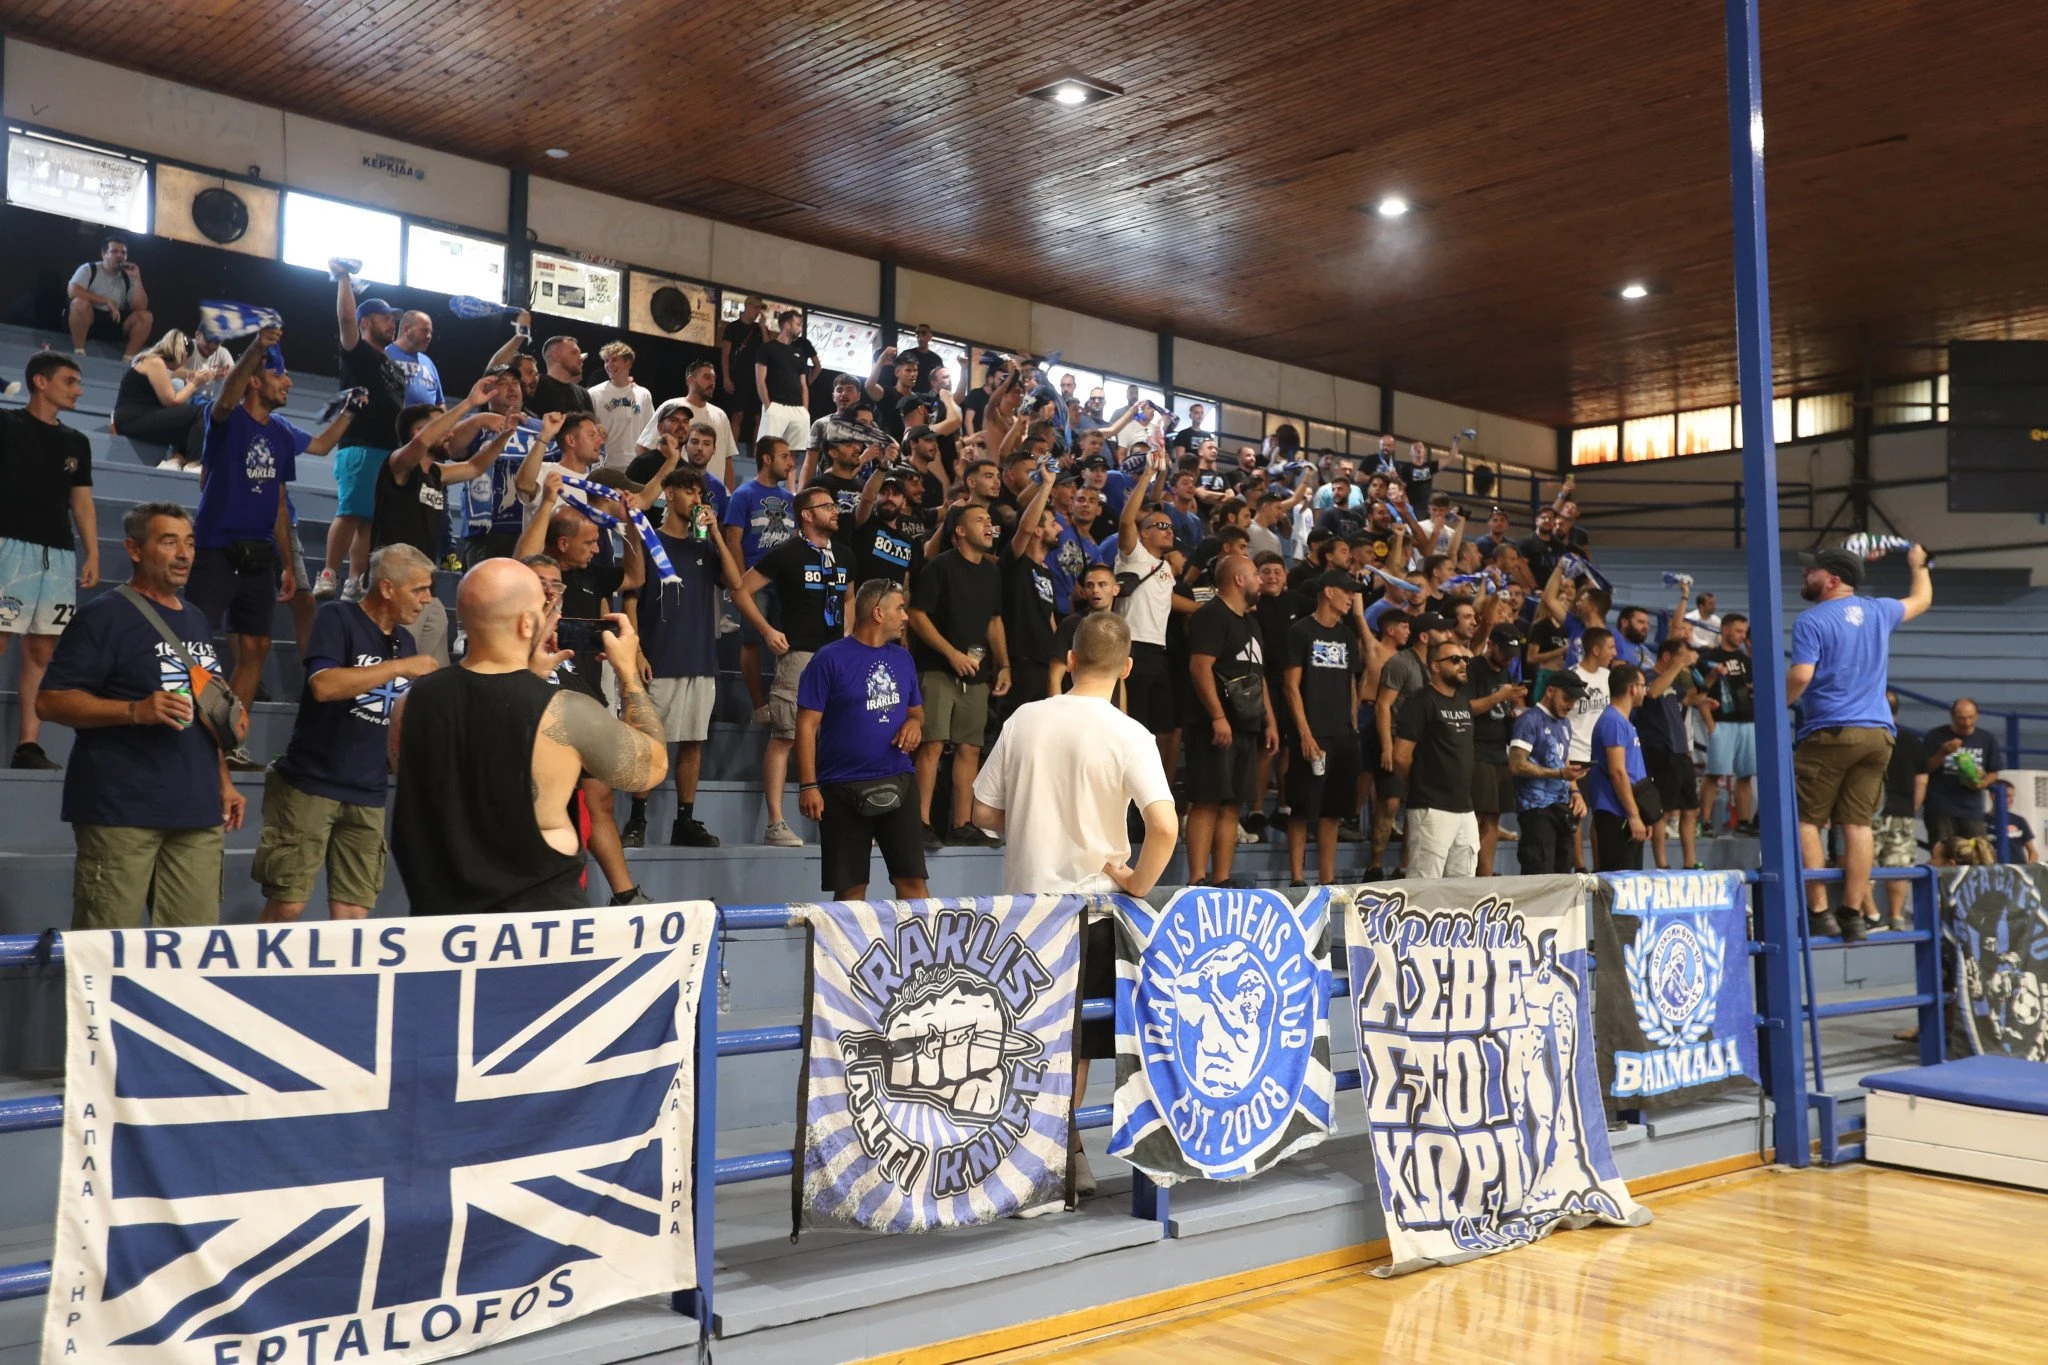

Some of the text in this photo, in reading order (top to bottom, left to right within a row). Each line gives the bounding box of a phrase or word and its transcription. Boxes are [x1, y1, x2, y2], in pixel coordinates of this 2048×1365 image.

[362, 156, 413, 177] ΚΕΡΚΙΔΑ
[155, 641, 217, 658] IRKLIS
[867, 692, 900, 711] IRAKLIS
[1614, 874, 1730, 911] ΗΡΑΚΛΗΣ
[110, 911, 686, 969] IRAKLIS GATE 10
[1144, 911, 1196, 1064] IRAKLIS
[1197, 890, 1291, 963] ATHENS
[1615, 1039, 1741, 1093] ΒΑΛΜΑΔΑ
[849, 1062, 1050, 1194] ANTI KNIFE
[1220, 1074, 1290, 1156] 2008
